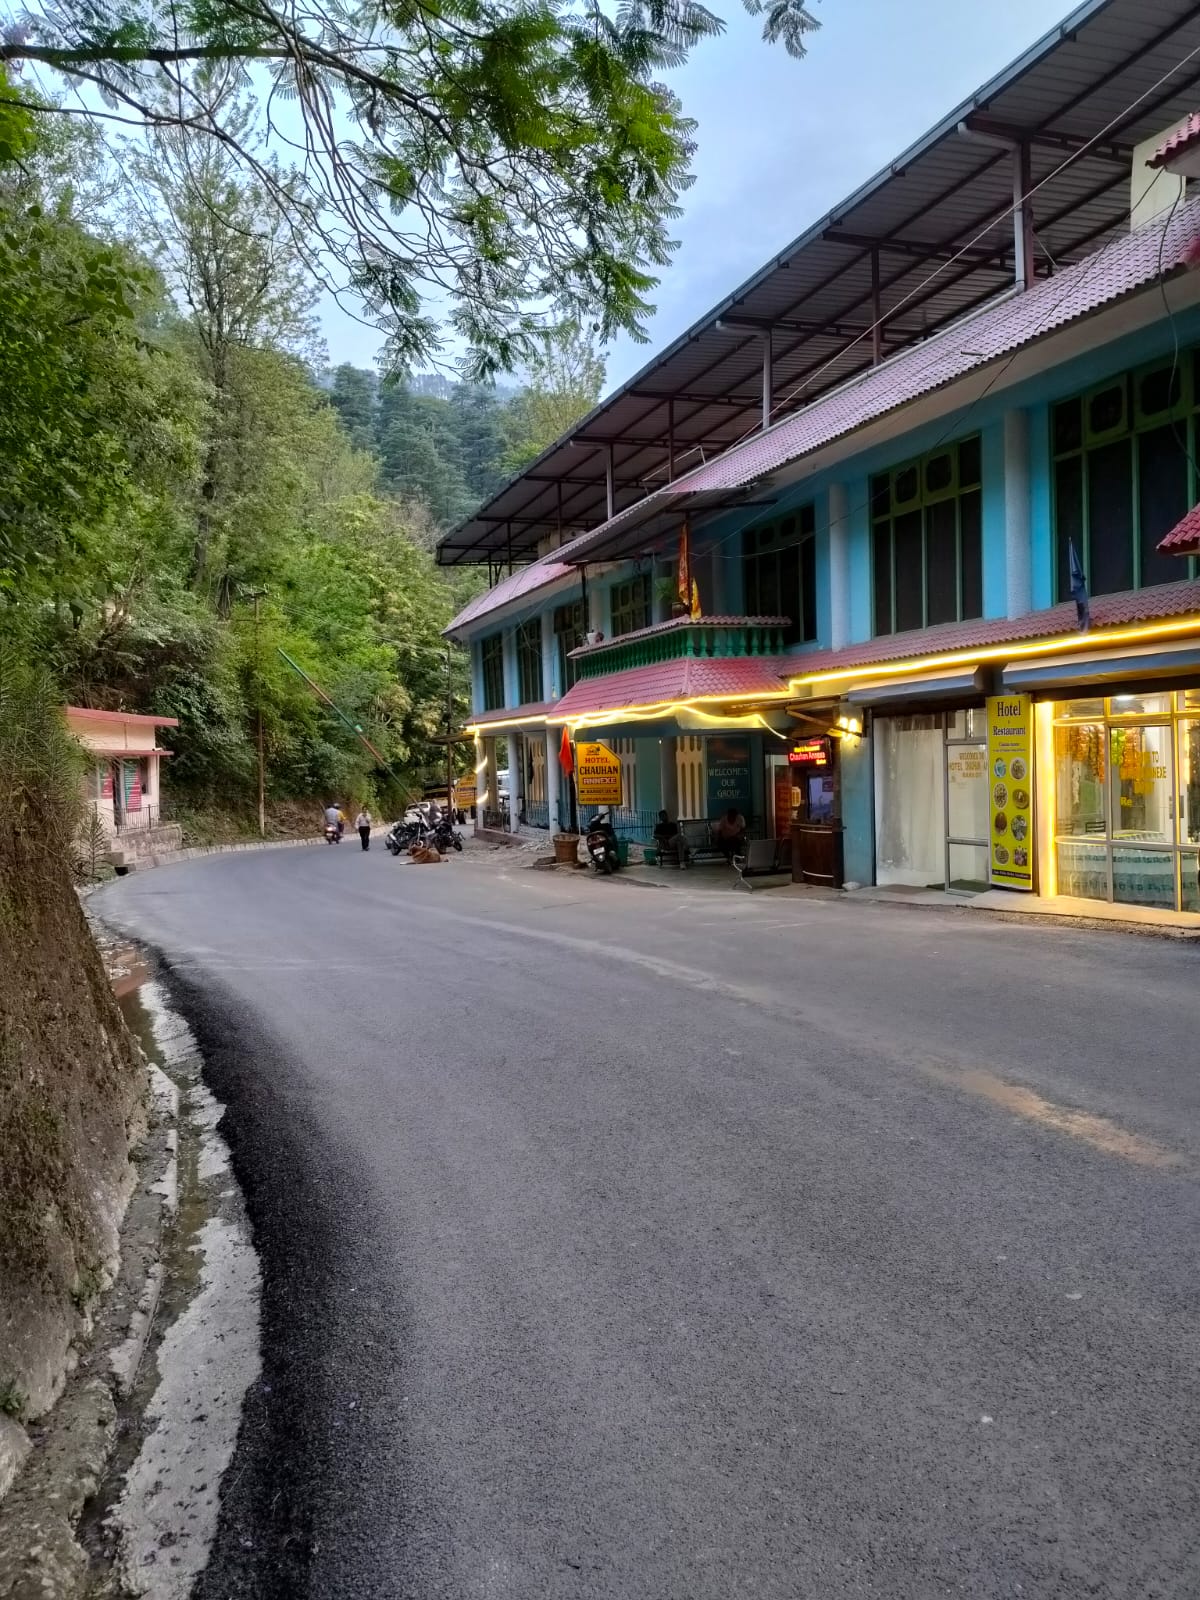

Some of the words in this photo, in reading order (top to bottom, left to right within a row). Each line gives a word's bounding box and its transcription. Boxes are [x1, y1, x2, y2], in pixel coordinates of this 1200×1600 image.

[997, 701, 1021, 717] Hotel
[993, 725, 1026, 736] Restaurant
[580, 765, 619, 775] CHAUHAN
